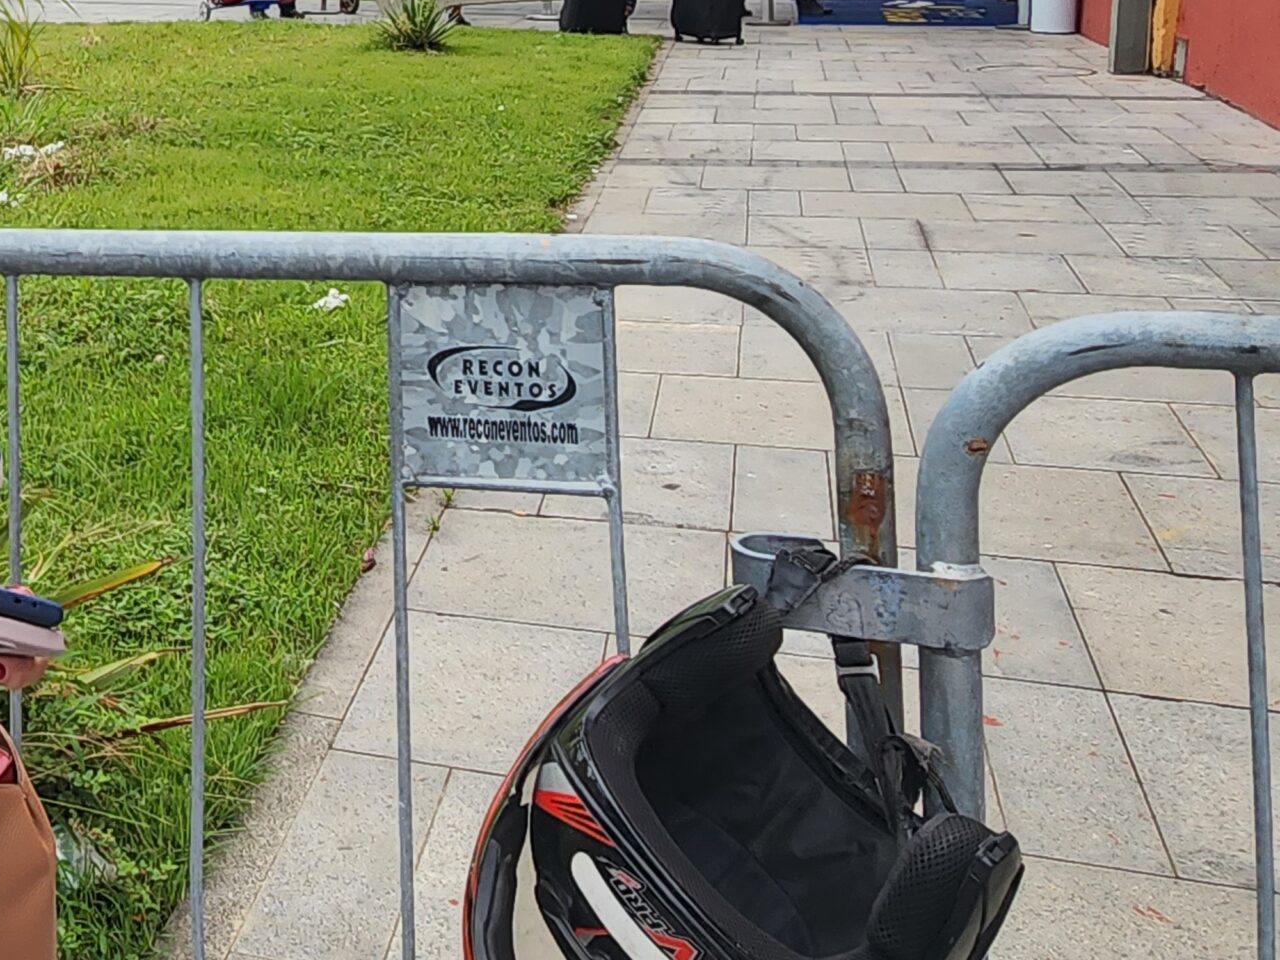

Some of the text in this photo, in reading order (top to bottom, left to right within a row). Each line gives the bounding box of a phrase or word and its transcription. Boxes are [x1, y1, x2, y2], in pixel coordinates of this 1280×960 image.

[462, 358, 541, 378] RECON
[453, 379, 558, 399] EVENTOS
[427, 414, 579, 445] www.reconeventos.com
